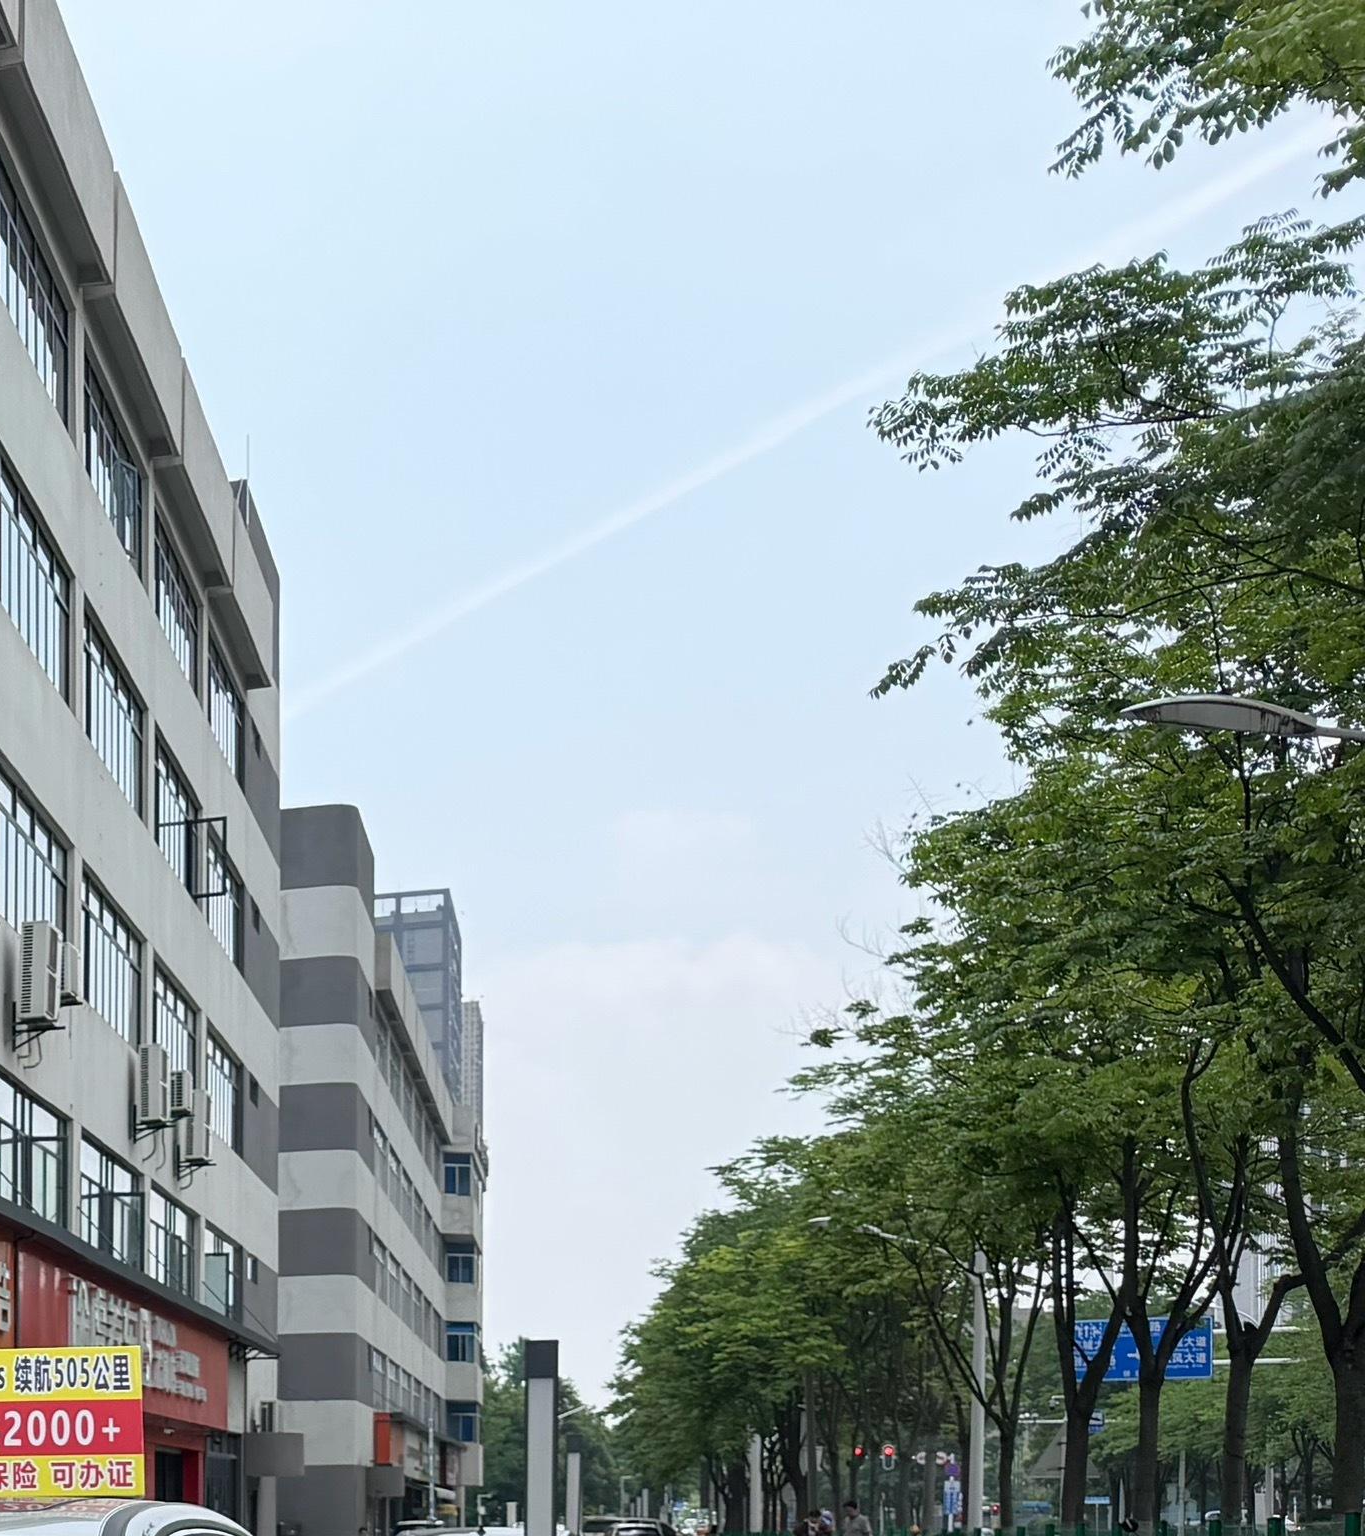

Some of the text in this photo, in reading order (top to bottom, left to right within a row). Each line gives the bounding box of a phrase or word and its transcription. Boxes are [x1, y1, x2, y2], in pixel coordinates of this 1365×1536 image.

[14, 1353, 132, 1394] 续航505公里
[50, 1459, 134, 1489] 可办证
